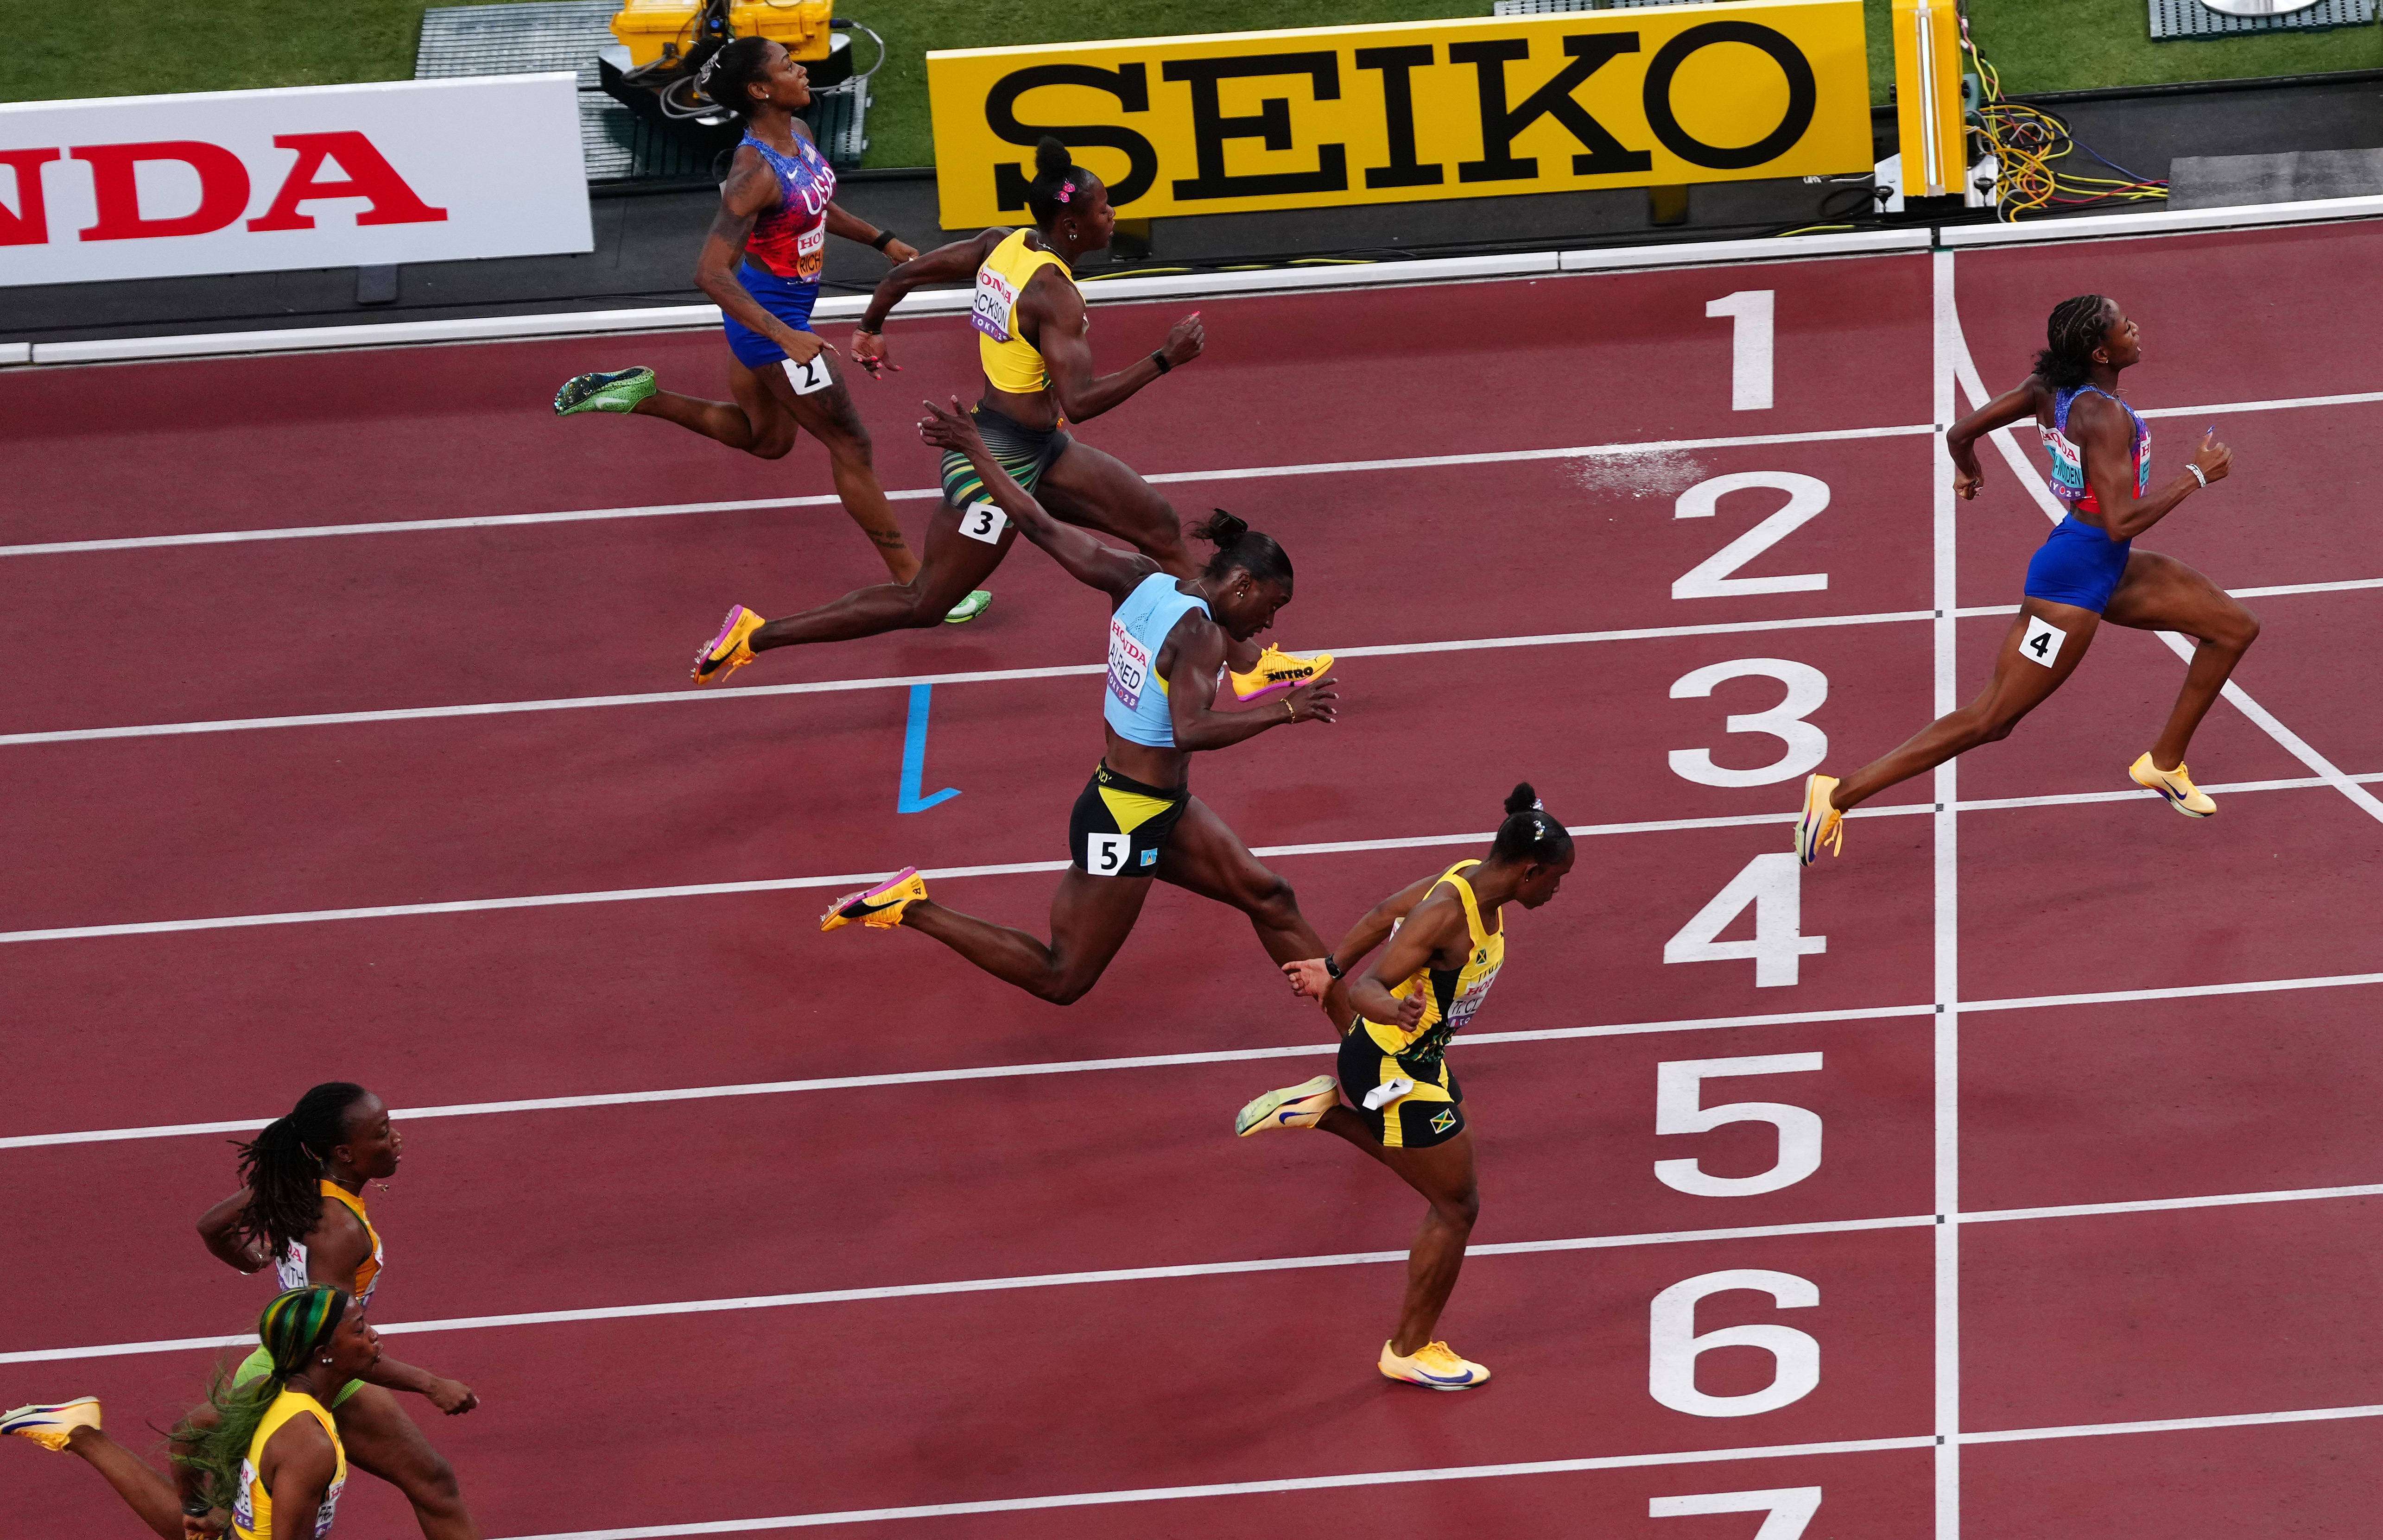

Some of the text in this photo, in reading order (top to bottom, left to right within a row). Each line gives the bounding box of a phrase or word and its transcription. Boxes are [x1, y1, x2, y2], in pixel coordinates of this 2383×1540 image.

[985, 20, 1816, 212] SEIKO
[801, 166, 837, 215] USA
[796, 361, 820, 388] 2
[1705, 290, 1775, 410] 1
[973, 511, 993, 535] 3
[1672, 471, 1831, 599] 2
[1109, 643, 1141, 689] ALFRED
[1264, 666, 1313, 682] NITRO
[2030, 632, 2052, 658] 4
[1669, 658, 1828, 787] 3
[1101, 842, 1118, 870] 5
[1663, 852, 1826, 987] 4
[1654, 1052, 1823, 1197] 5
[1649, 1269, 1819, 1417] 6
